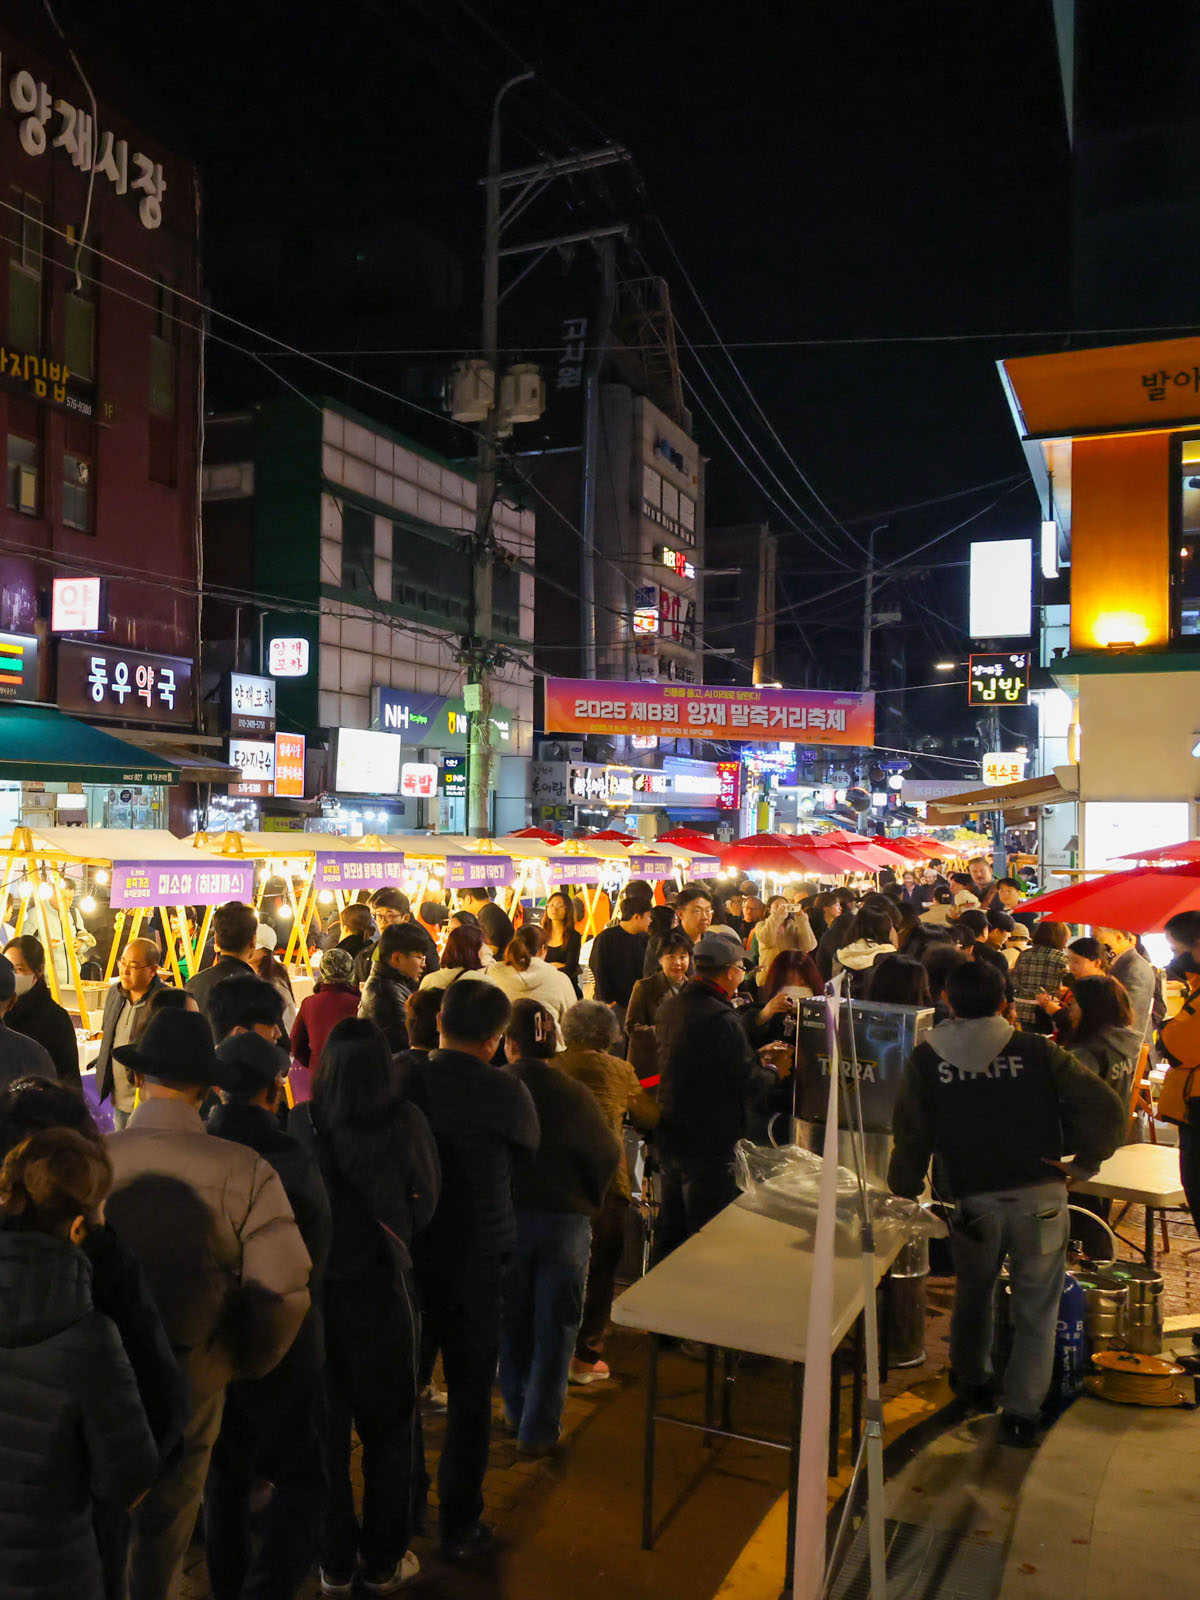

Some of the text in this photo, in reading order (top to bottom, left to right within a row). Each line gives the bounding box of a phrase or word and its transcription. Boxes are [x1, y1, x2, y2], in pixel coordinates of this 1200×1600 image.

[59, 584, 91, 627] 약
[273, 641, 303, 656] 양재
[87, 655, 177, 711] 동우약국
[704, 690, 712, 699] AI
[971, 677, 1025, 701] 김밥
[235, 684, 273, 709] 양재포차
[385, 703, 409, 729] NH
[575, 700, 846, 731] 2025 제8회 양재 말죽거리축제
[233, 749, 272, 773] 도라지국수
[986, 764, 1021, 781] 색소폰
[403, 774, 433, 794] 족발
[720, 771, 734, 806] 노래방
[158, 873, 192, 895] 미소야
[817, 1057, 876, 1084] TRRA
